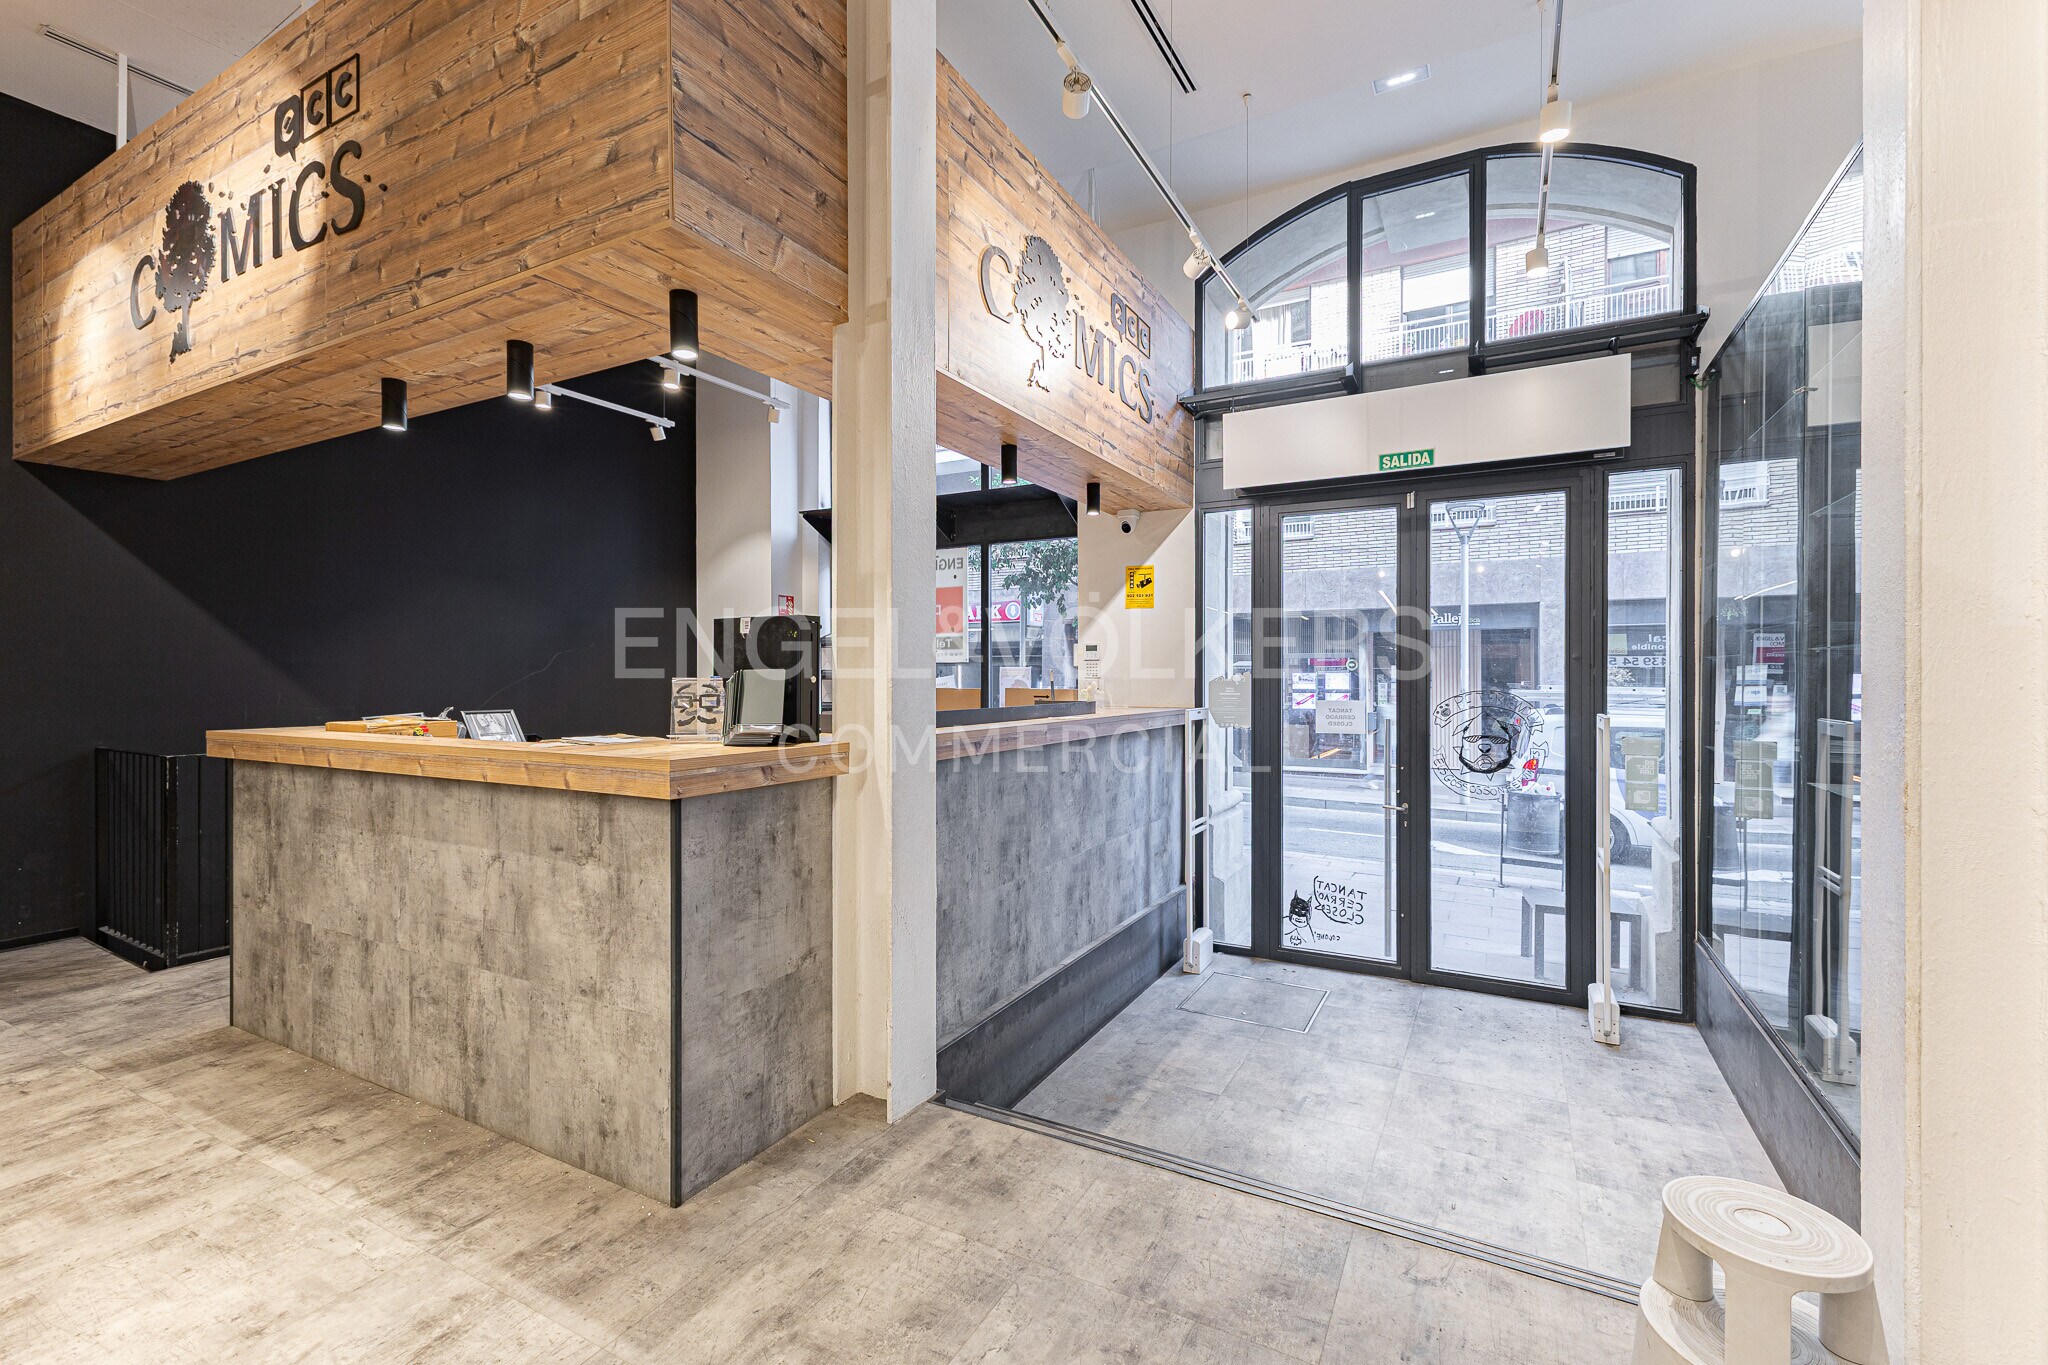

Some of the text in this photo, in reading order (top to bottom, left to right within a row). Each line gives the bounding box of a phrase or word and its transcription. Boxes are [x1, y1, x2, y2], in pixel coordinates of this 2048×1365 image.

[130, 139, 366, 331] CMICS
[977, 244, 1153, 425] CMICS
[1382, 451, 1431, 469] SALIDA
[1430, 613, 1462, 626] Pallej
